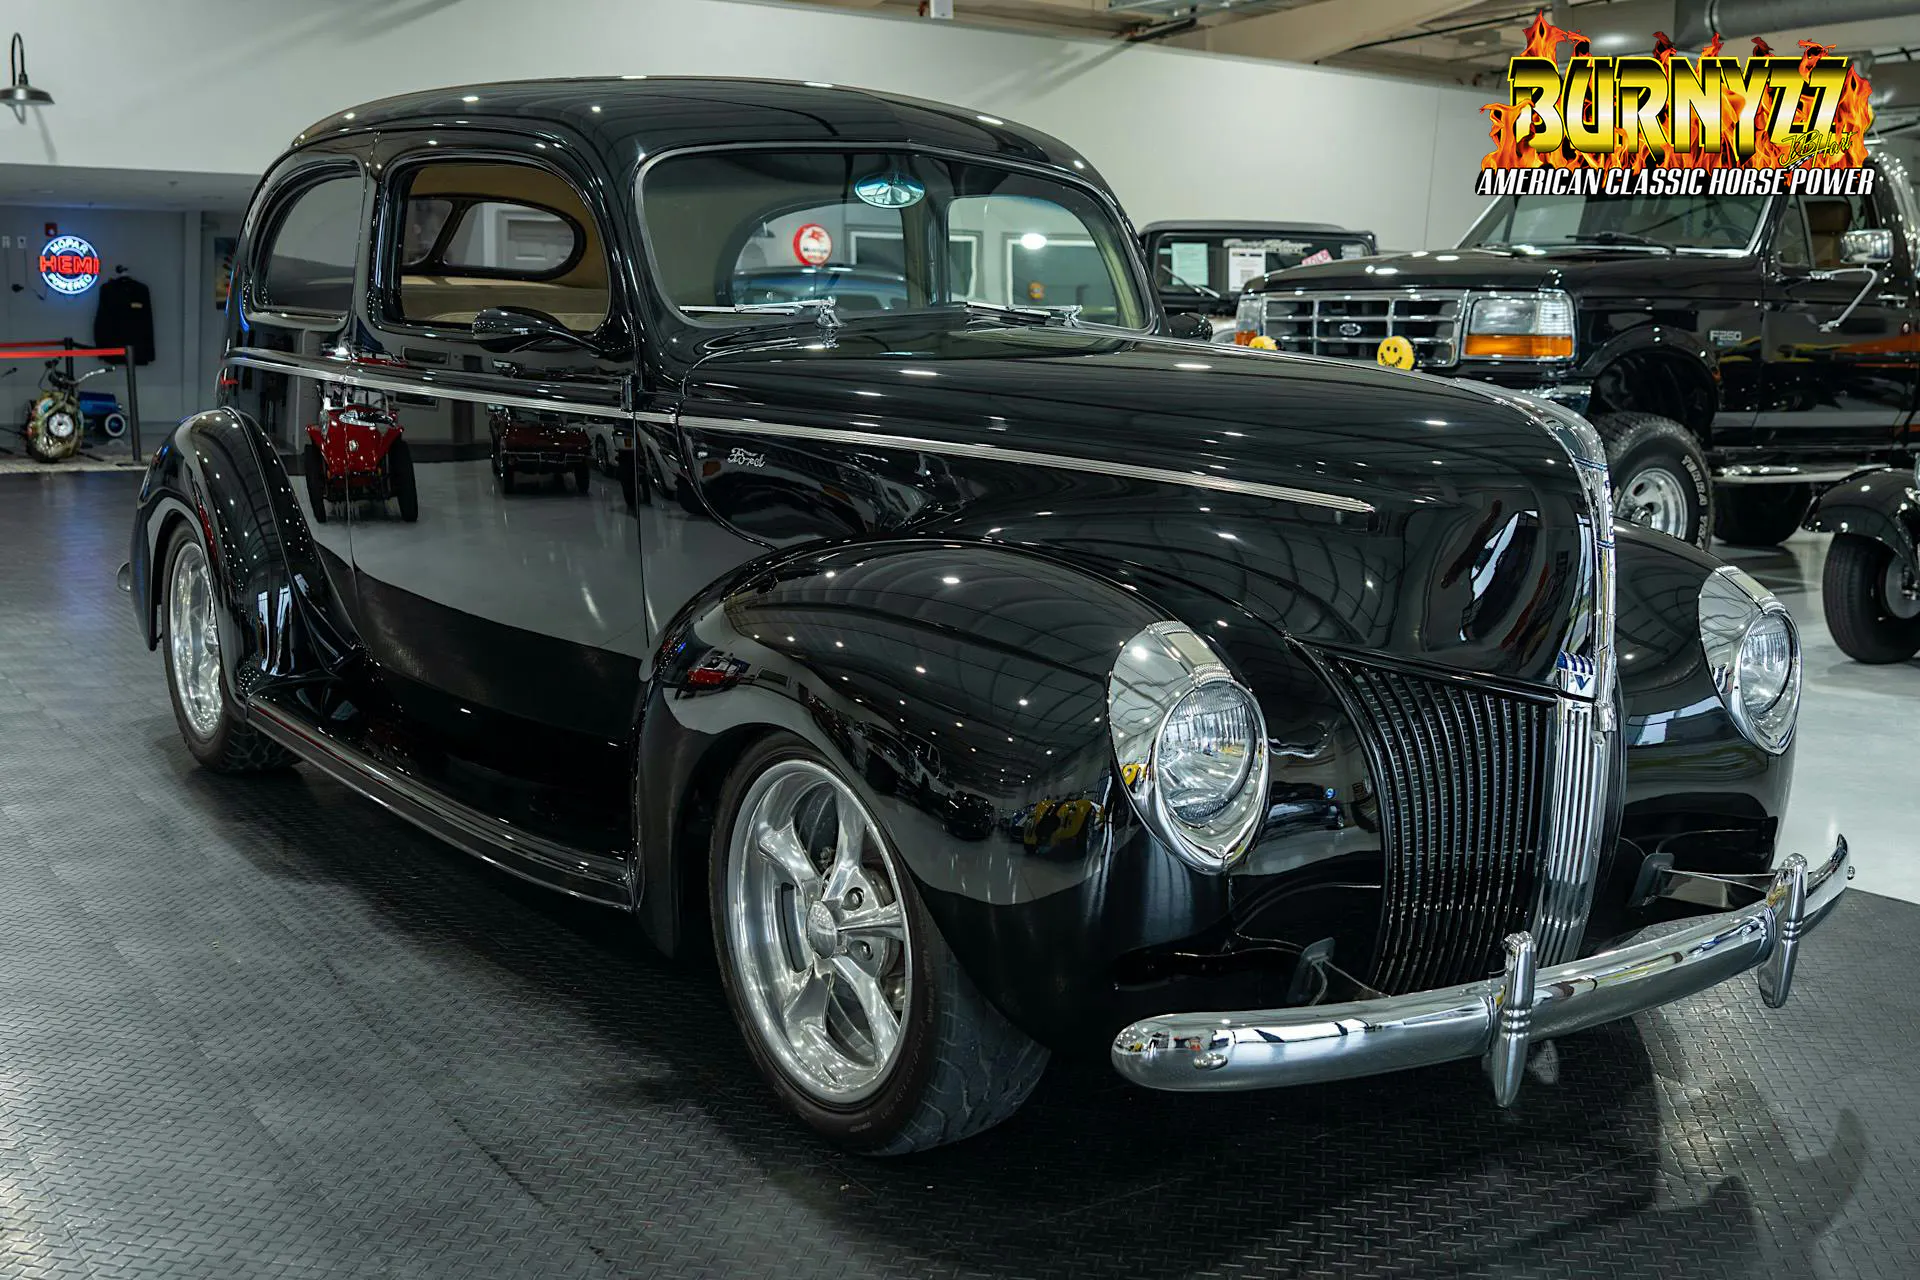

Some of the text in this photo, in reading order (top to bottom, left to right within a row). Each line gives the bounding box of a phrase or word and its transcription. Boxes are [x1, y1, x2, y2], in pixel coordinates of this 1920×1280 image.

[49, 238, 89, 254] MOPAR
[39, 255, 100, 275] HEMI
[48, 272, 93, 291] POWERED
[727, 447, 766, 467] Ford
